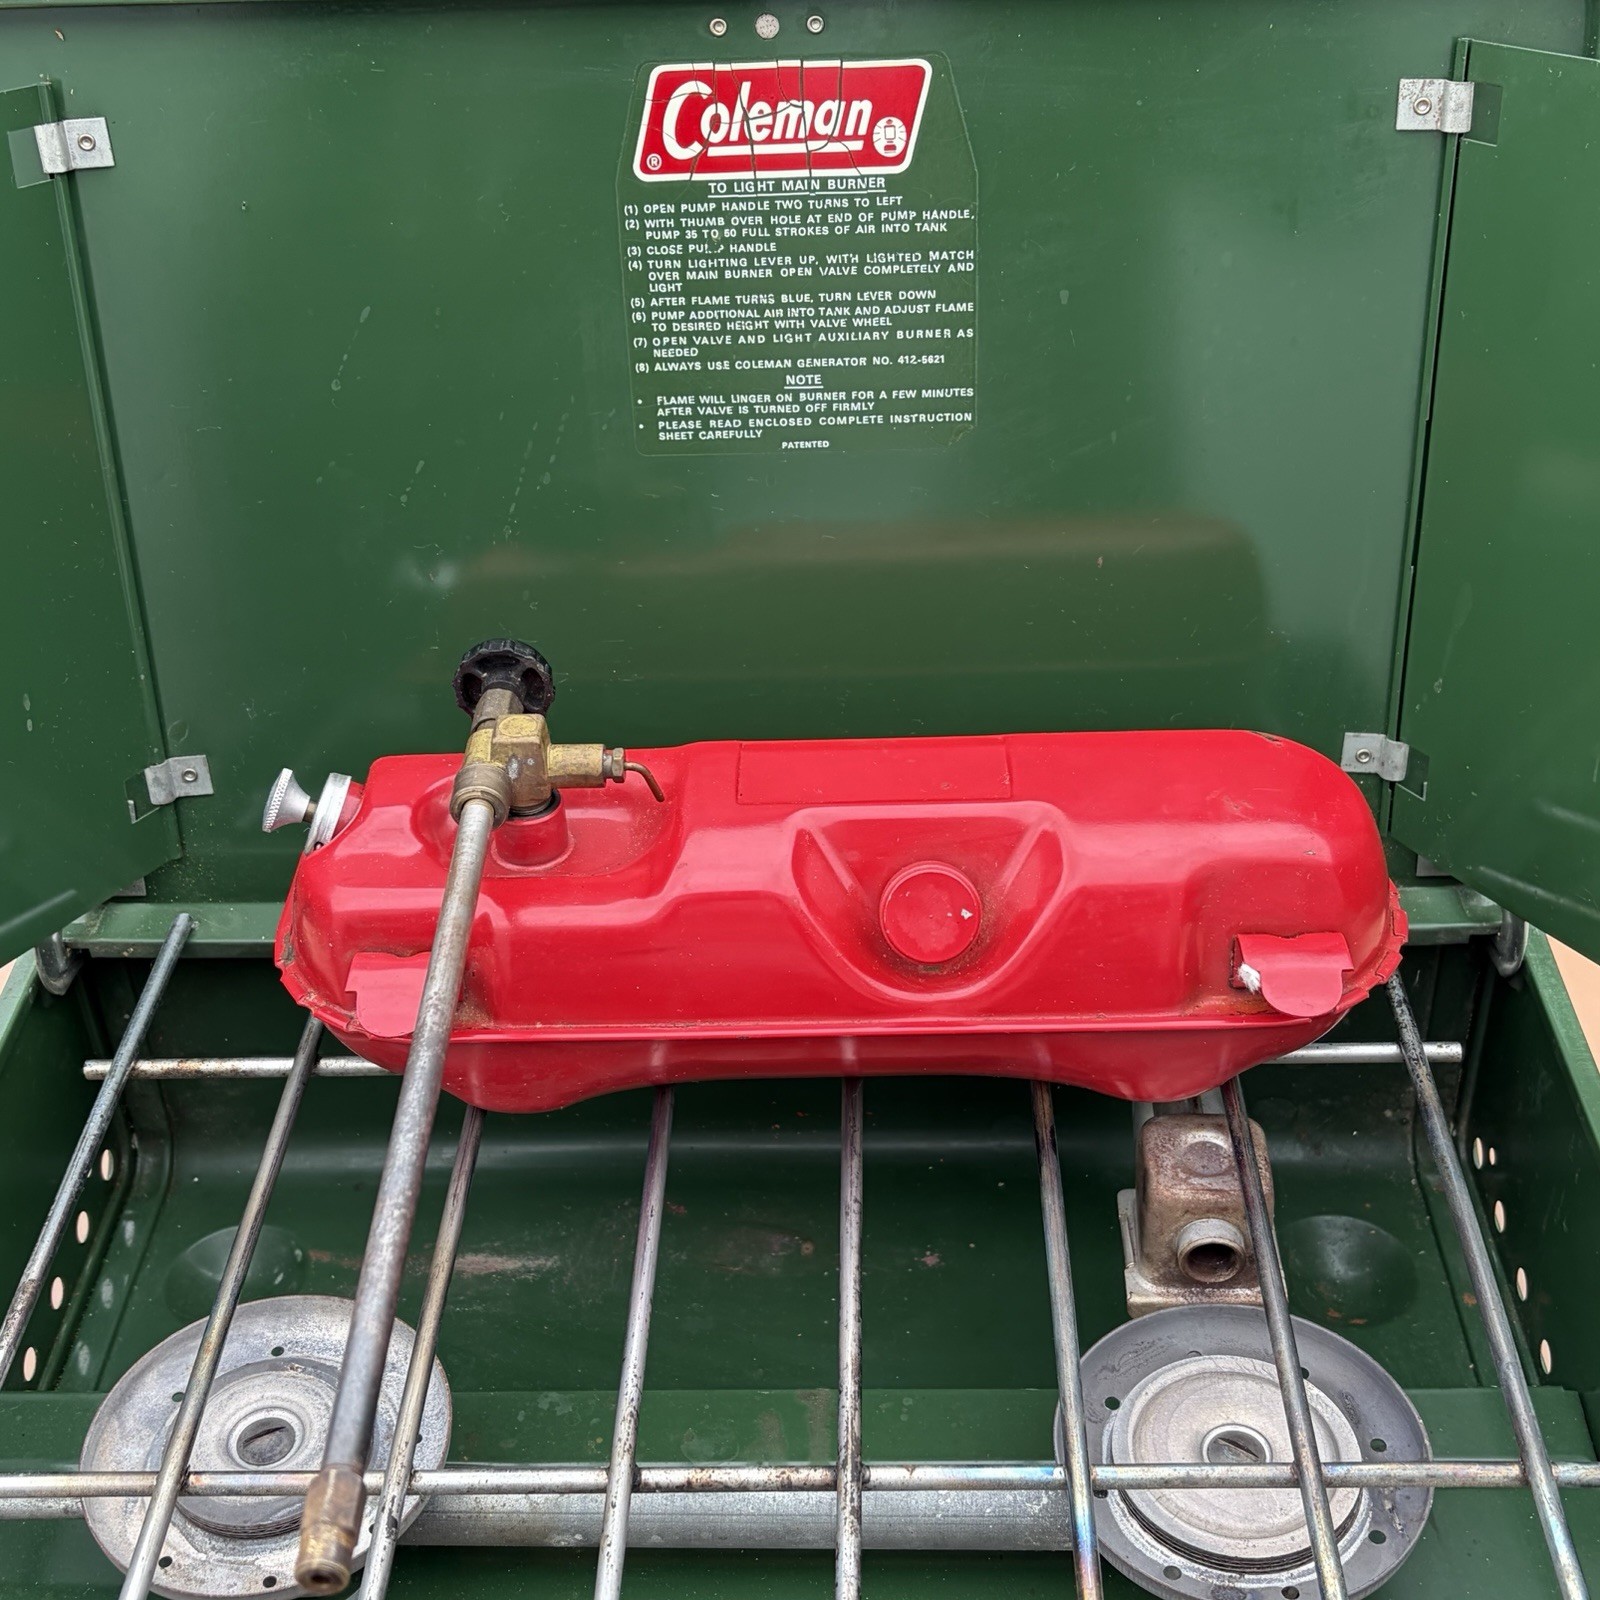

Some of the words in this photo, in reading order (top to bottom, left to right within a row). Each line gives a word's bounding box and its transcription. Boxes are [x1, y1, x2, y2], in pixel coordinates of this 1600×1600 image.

[662, 81, 874, 160] Coleman
[707, 182, 727, 193] TO
[734, 180, 775, 192] LIGHT
[782, 178, 820, 191] MAIN
[828, 176, 885, 189] BURNER
[624, 204, 639, 216] (1)
[644, 203, 675, 213] OPEN
[681, 202, 716, 212] PUMP
[722, 200, 770, 211] HANDLE
[774, 199, 803, 210] TWO
[808, 198, 849, 209] TURNS
[853, 197, 870, 207] TO
[876, 195, 903, 205] LEFT
[625, 219, 640, 230] (2)
[644, 218, 675, 228] WITH
[680, 216, 725, 227] THUMB
[731, 215, 763, 225] OVER
[770, 214, 801, 224] HOLE
[805, 214, 822, 223] AT
[828, 212, 853, 223] END
[857, 212, 874, 222] OF
[881, 210, 917, 221] PUMP
[646, 230, 680, 239] PUMP
[684, 229, 698, 239] 35
[701, 228, 721, 239] TO
[723, 228, 737, 237] 50
[742, 227, 771, 236] FULL
[775, 225, 829, 236] STROKES
[833, 224, 850, 234] OF
[855, 224, 876, 233] AIR
[882, 223, 910, 232] INTO
[914, 222, 948, 232] TANK
[627, 245, 641, 257] (3)
[646, 244, 683, 255] CLOSE
[730, 242, 777, 252] HANDLE
[628, 260, 643, 271] (4)
[647, 259, 681, 269] TURN
[688, 257, 747, 268] LIGHTING
[754, 256, 792, 266] LEVER
[826, 253, 859, 264] WITH
[866, 252, 922, 263] LIGHTED
[929, 249, 974, 261] MATCH
[648, 271, 680, 280] OVER
[686, 270, 718, 279] MAIN
[724, 268, 773, 278] BURNER
[780, 266, 812, 277] OPEN
[819, 265, 858, 276] VALVE
[864, 263, 941, 275] COMPLETELY
[948, 262, 975, 272] AND
[649, 282, 683, 292] LIGHT
[630, 297, 645, 308] (5)
[650, 296, 686, 306] AFTER
[691, 295, 731, 305] FLAME
[735, 293, 775, 304] TURNS
[818, 291, 852, 302] TURN
[857, 290, 893, 301] LEVER
[898, 289, 936, 299] DOWN
[632, 311, 647, 323] (6)
[652, 310, 685, 320] PUMP
[689, 309, 761, 319] ADDITIONAL
[764, 308, 784, 317] AIR
[787, 307, 815, 317] INTO
[818, 306, 851, 316] TANK
[854, 305, 881, 315] AND
[884, 303, 931, 314] ADJUST
[935, 302, 974, 312] FLAME
[650, 322, 667, 331] TO
[672, 321, 721, 331] DESIRED
[726, 320, 770, 330] HEIGHT
[774, 319, 805, 329] WITH
[810, 318, 847, 328] VALVE
[852, 316, 893, 326] WHEEL
[633, 337, 647, 348] (7)
[652, 336, 687, 346] OPEN
[692, 335, 732, 344] VALVE
[738, 334, 766, 343] AND
[773, 332, 812, 343] LIGHT
[818, 330, 889, 341] AUXILIARY
[896, 328, 951, 339] BURNER
[955, 328, 974, 337] AS
[653, 347, 699, 357] NEEDED
[635, 362, 649, 373] (8)
[654, 361, 702, 371] ALWAYS
[707, 360, 730, 370] USE
[735, 358, 792, 369] COLEMAN
[797, 356, 867, 367] GENERATOR
[872, 355, 893, 365] NO.
[897, 354, 945, 364] 412-5621
[786, 374, 822, 385] NOTE
[657, 395, 695, 405] FLAME
[699, 395, 726, 403] WILL
[731, 394, 771, 403] LINGER
[775, 392, 793, 402] ON
[799, 391, 846, 401] BURNER
[852, 390, 874, 399] FOR
[878, 390, 888, 399] A
[892, 389, 917, 398] FEW
[922, 387, 974, 397] MINUTES
[657, 406, 692, 416] AFTER
[697, 405, 733, 415] VALVE
[737, 405, 749, 414] IS
[753, 404, 800, 413] TURNED
[805, 402, 827, 412] OFF
[832, 401, 875, 411] FIRMLY
[658, 420, 702, 429] PLEASE
[709, 419, 742, 428] READ
[748, 417, 812, 427] ENCLOSED
[819, 414, 884, 425] COMPLETE
[890, 412, 972, 423] INSTRUCTION
[659, 431, 694, 440] SHEET
[698, 429, 763, 439] CAREFULLY
[782, 440, 830, 448] PATENTED
